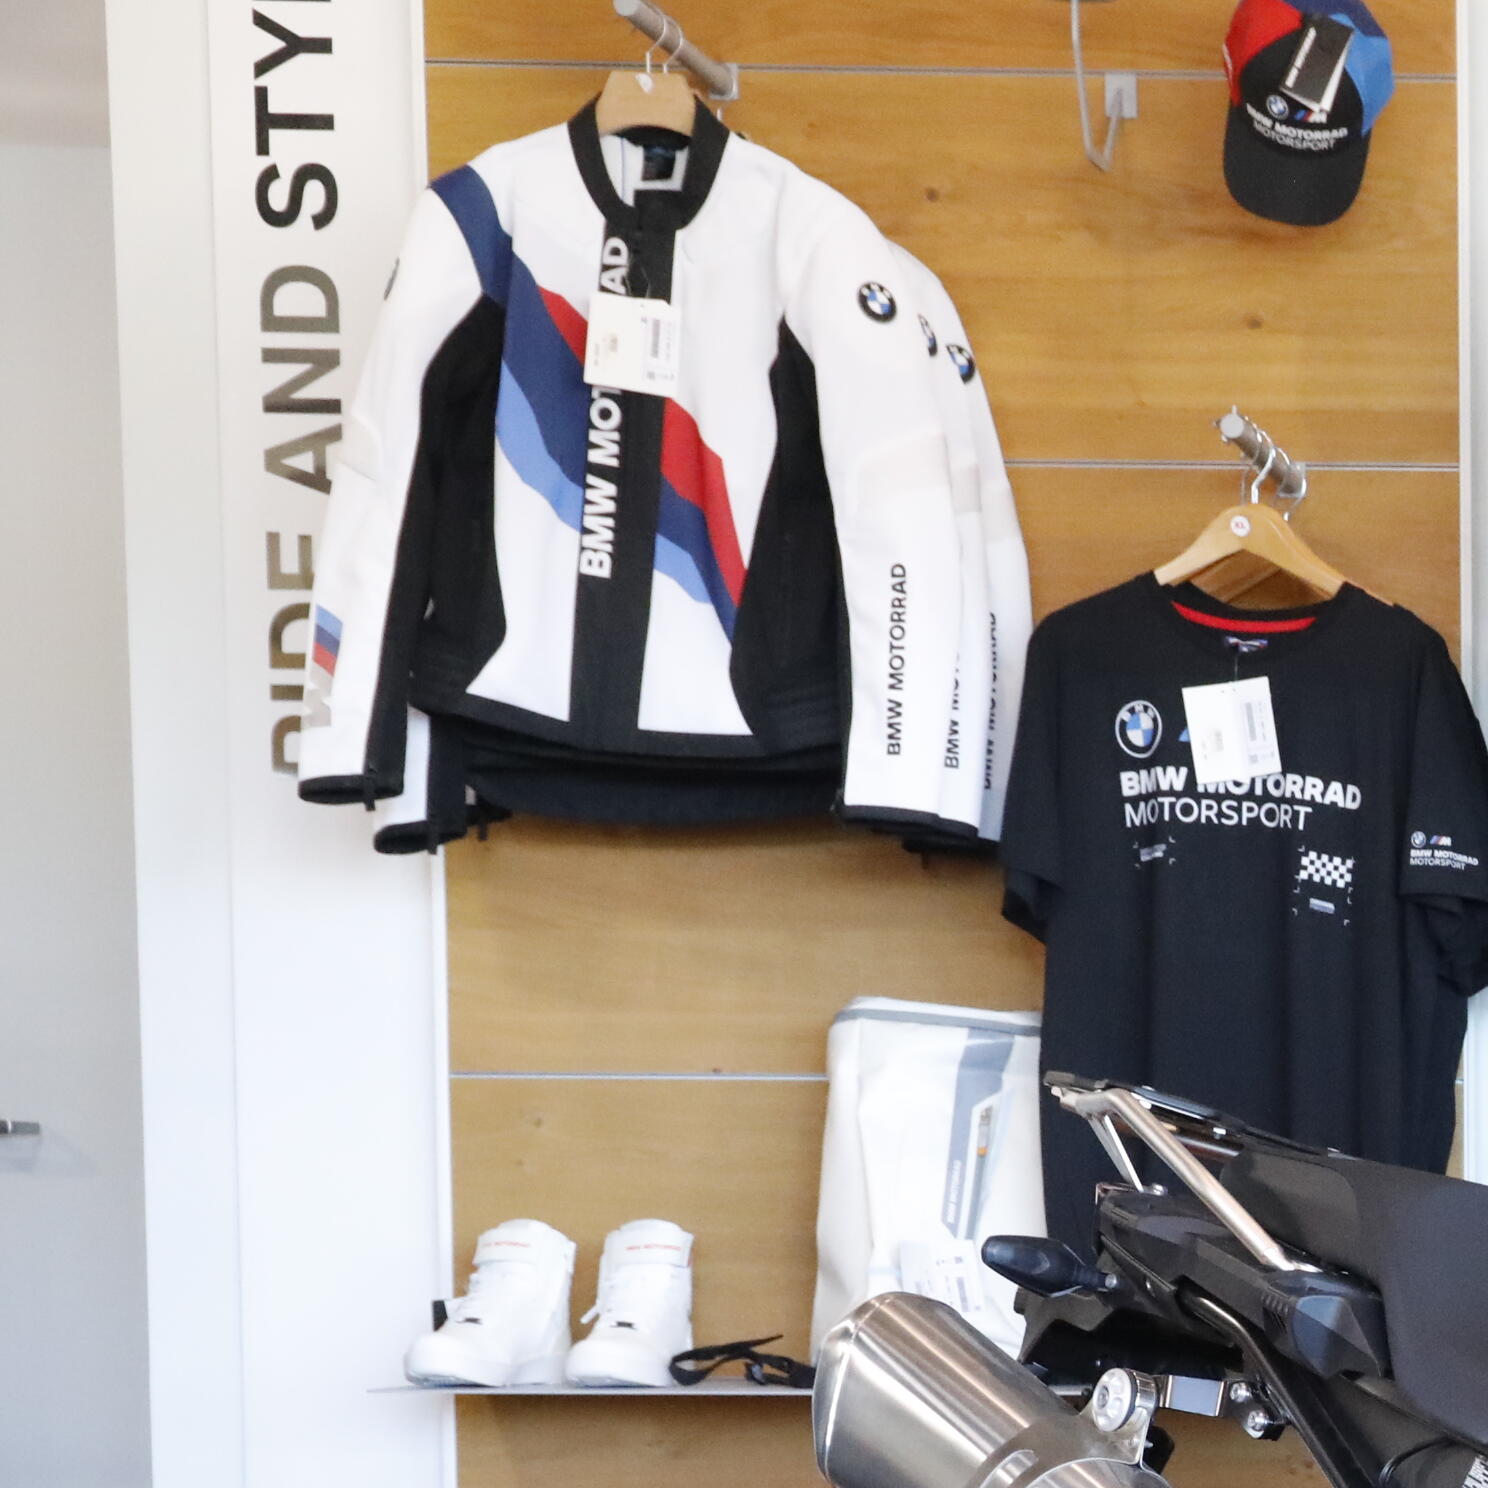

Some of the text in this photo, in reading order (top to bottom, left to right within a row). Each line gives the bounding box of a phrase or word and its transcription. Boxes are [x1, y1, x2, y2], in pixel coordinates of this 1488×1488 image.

[252, 0, 339, 231] STY
[260, 264, 342, 496] AND
[578, 236, 630, 579] BMW MOAD
[886, 563, 907, 756] BMW MOTORRAD
[944, 719, 961, 770] BMW
[1119, 766, 1189, 798] BMW
[1123, 797, 1313, 831] MOTORSPORT
[1409, 857, 1467, 871] MOTORSPORT
[1410, 848, 1479, 867] BMW MOTORRAD
